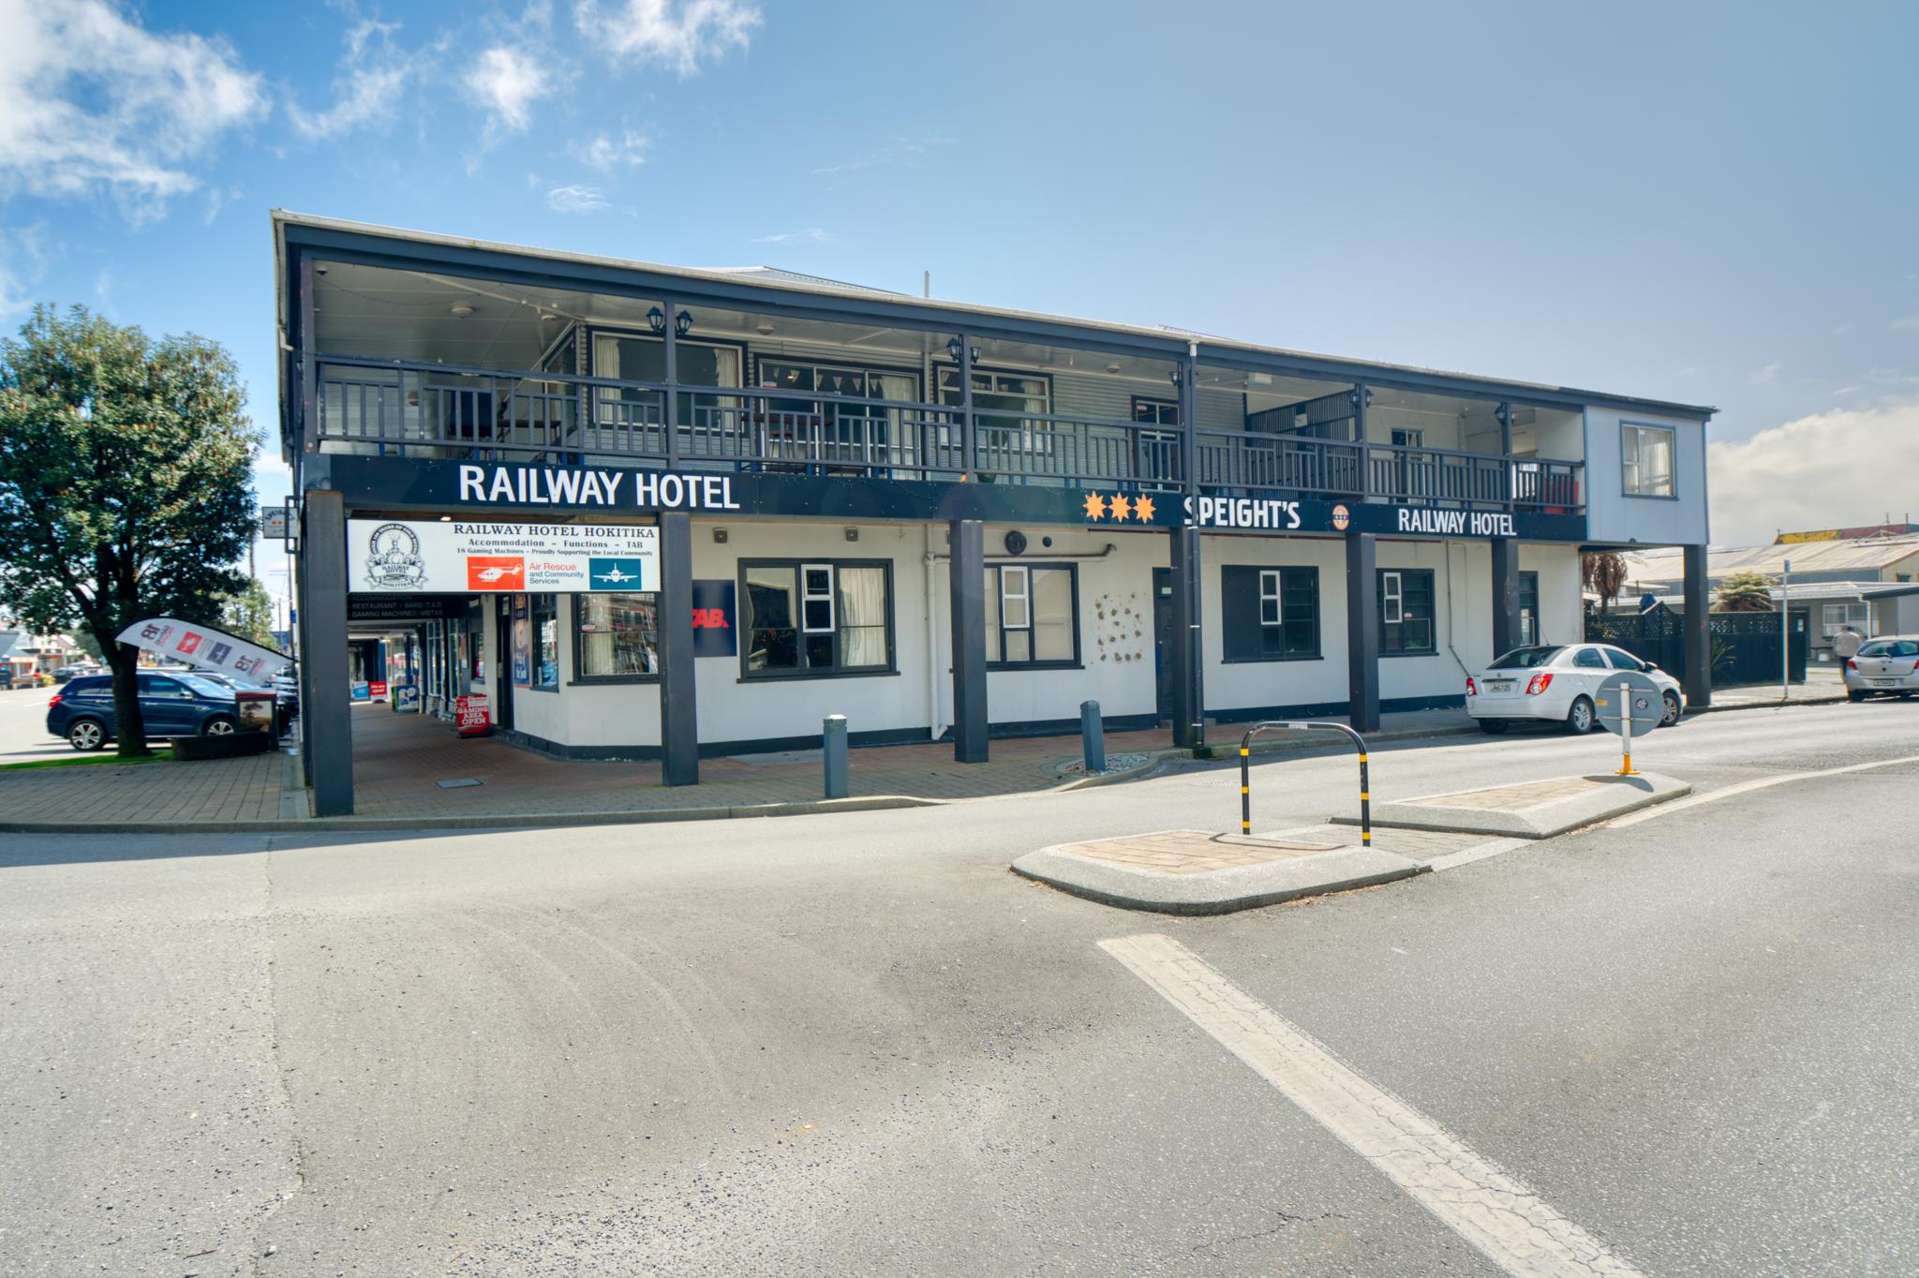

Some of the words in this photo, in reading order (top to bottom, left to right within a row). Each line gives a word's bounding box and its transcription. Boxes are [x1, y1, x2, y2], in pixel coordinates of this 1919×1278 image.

[460, 464, 624, 505] RAILWAY
[635, 472, 740, 509] HOTEL
[1184, 496, 1301, 529] SPEIGHT'S
[1398, 508, 1466, 534] RAILWAY
[1471, 512, 1517, 536] HOTEL
[454, 524, 523, 535] RAILWAY
[528, 525, 579, 537] HOTEL
[584, 526, 655, 538] HOKITIKA
[469, 538, 545, 547] Accommodation
[563, 540, 608, 548] Functions
[626, 541, 643, 549] TAB
[529, 562, 541, 571] Air
[543, 562, 577, 571] Rescue
[529, 577, 560, 585] Services
